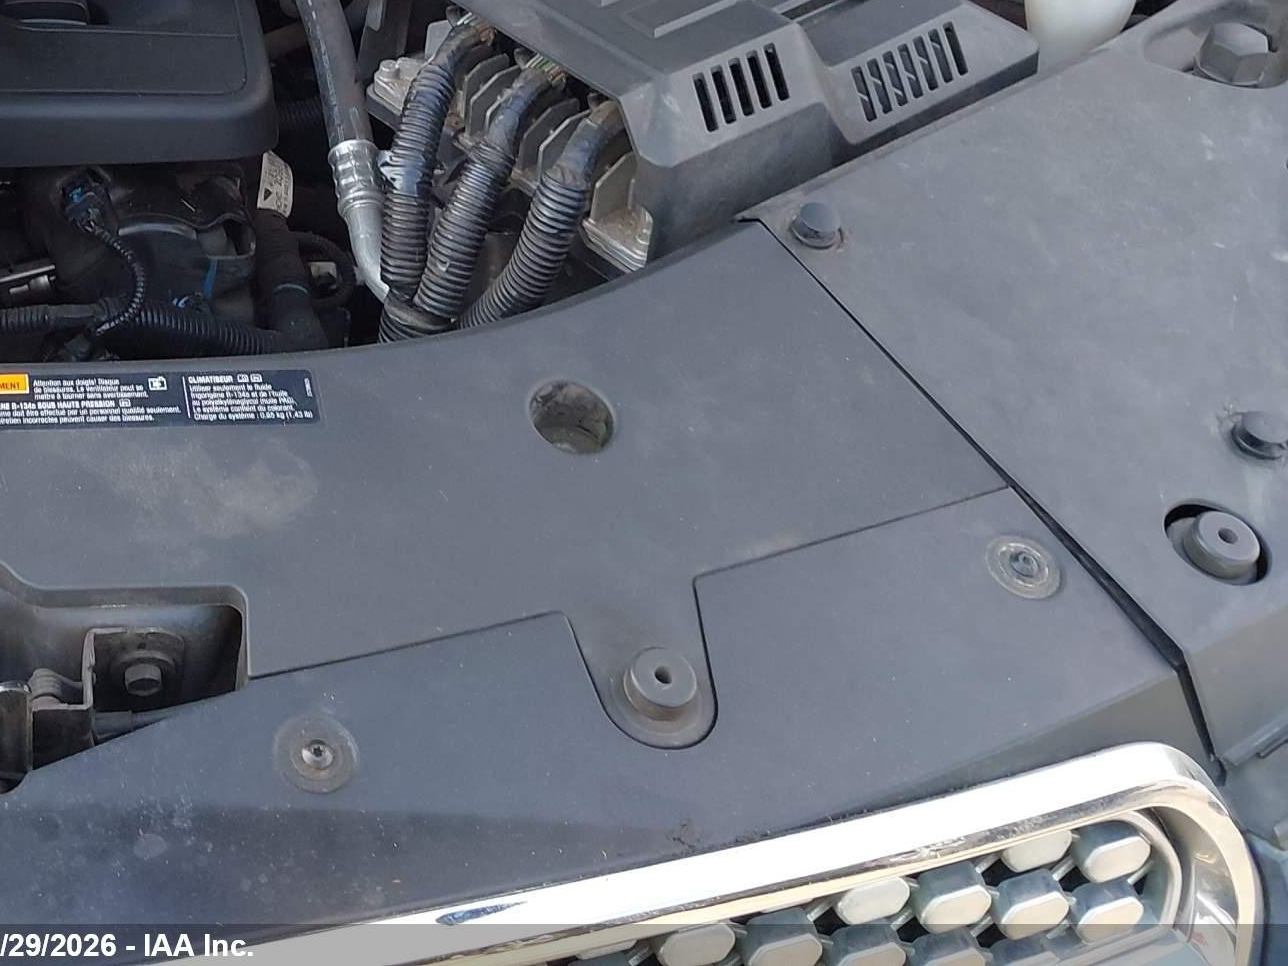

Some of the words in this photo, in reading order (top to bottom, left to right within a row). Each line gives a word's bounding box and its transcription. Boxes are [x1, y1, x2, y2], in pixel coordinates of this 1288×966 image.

[12, 401, 36, 410] R-134a
[57, 400, 80, 409] HAUTE
[81, 399, 115, 408] PRESSION
